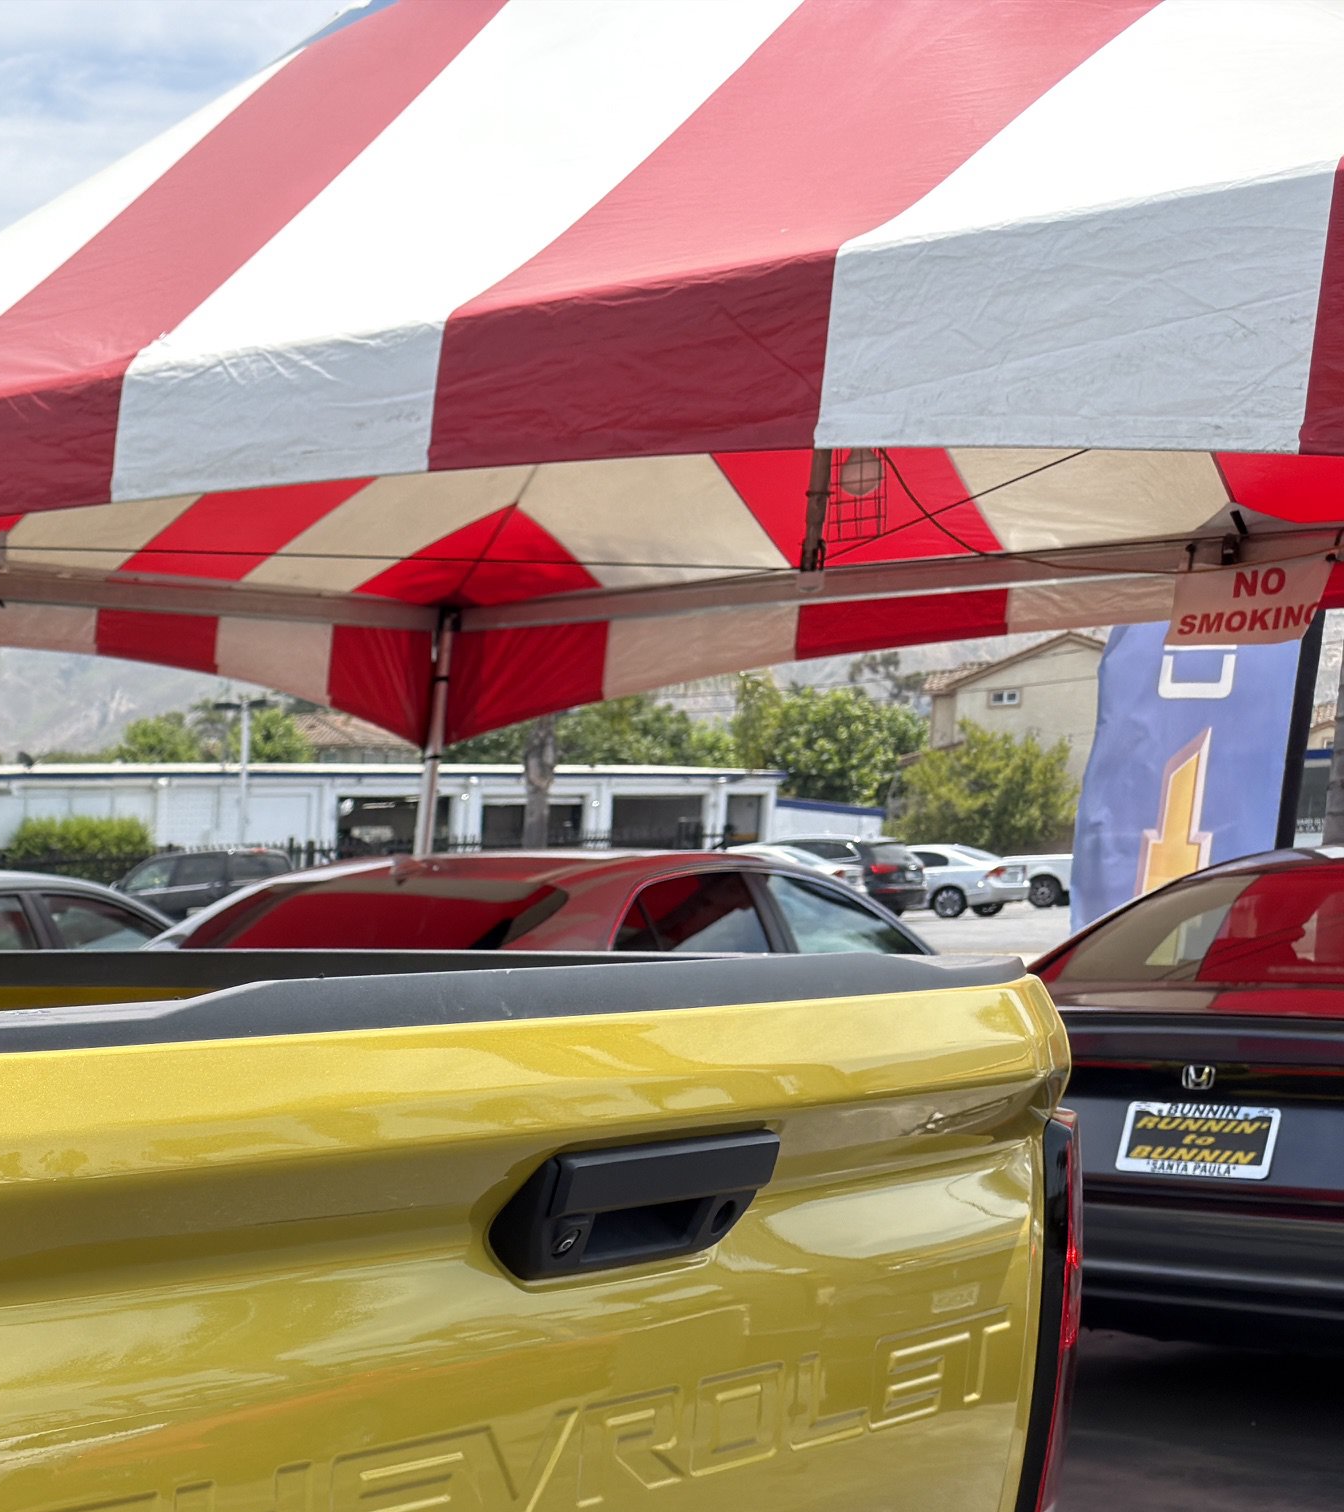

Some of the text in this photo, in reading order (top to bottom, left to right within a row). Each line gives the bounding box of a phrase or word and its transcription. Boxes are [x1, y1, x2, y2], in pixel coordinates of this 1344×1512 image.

[1233, 567, 1286, 598] NO
[1167, 1103, 1241, 1118] BUNNIN
[1136, 1116, 1269, 1134] RUNNIN'
[1182, 1133, 1216, 1146] to
[1129, 1145, 1257, 1165] BUNNIN
